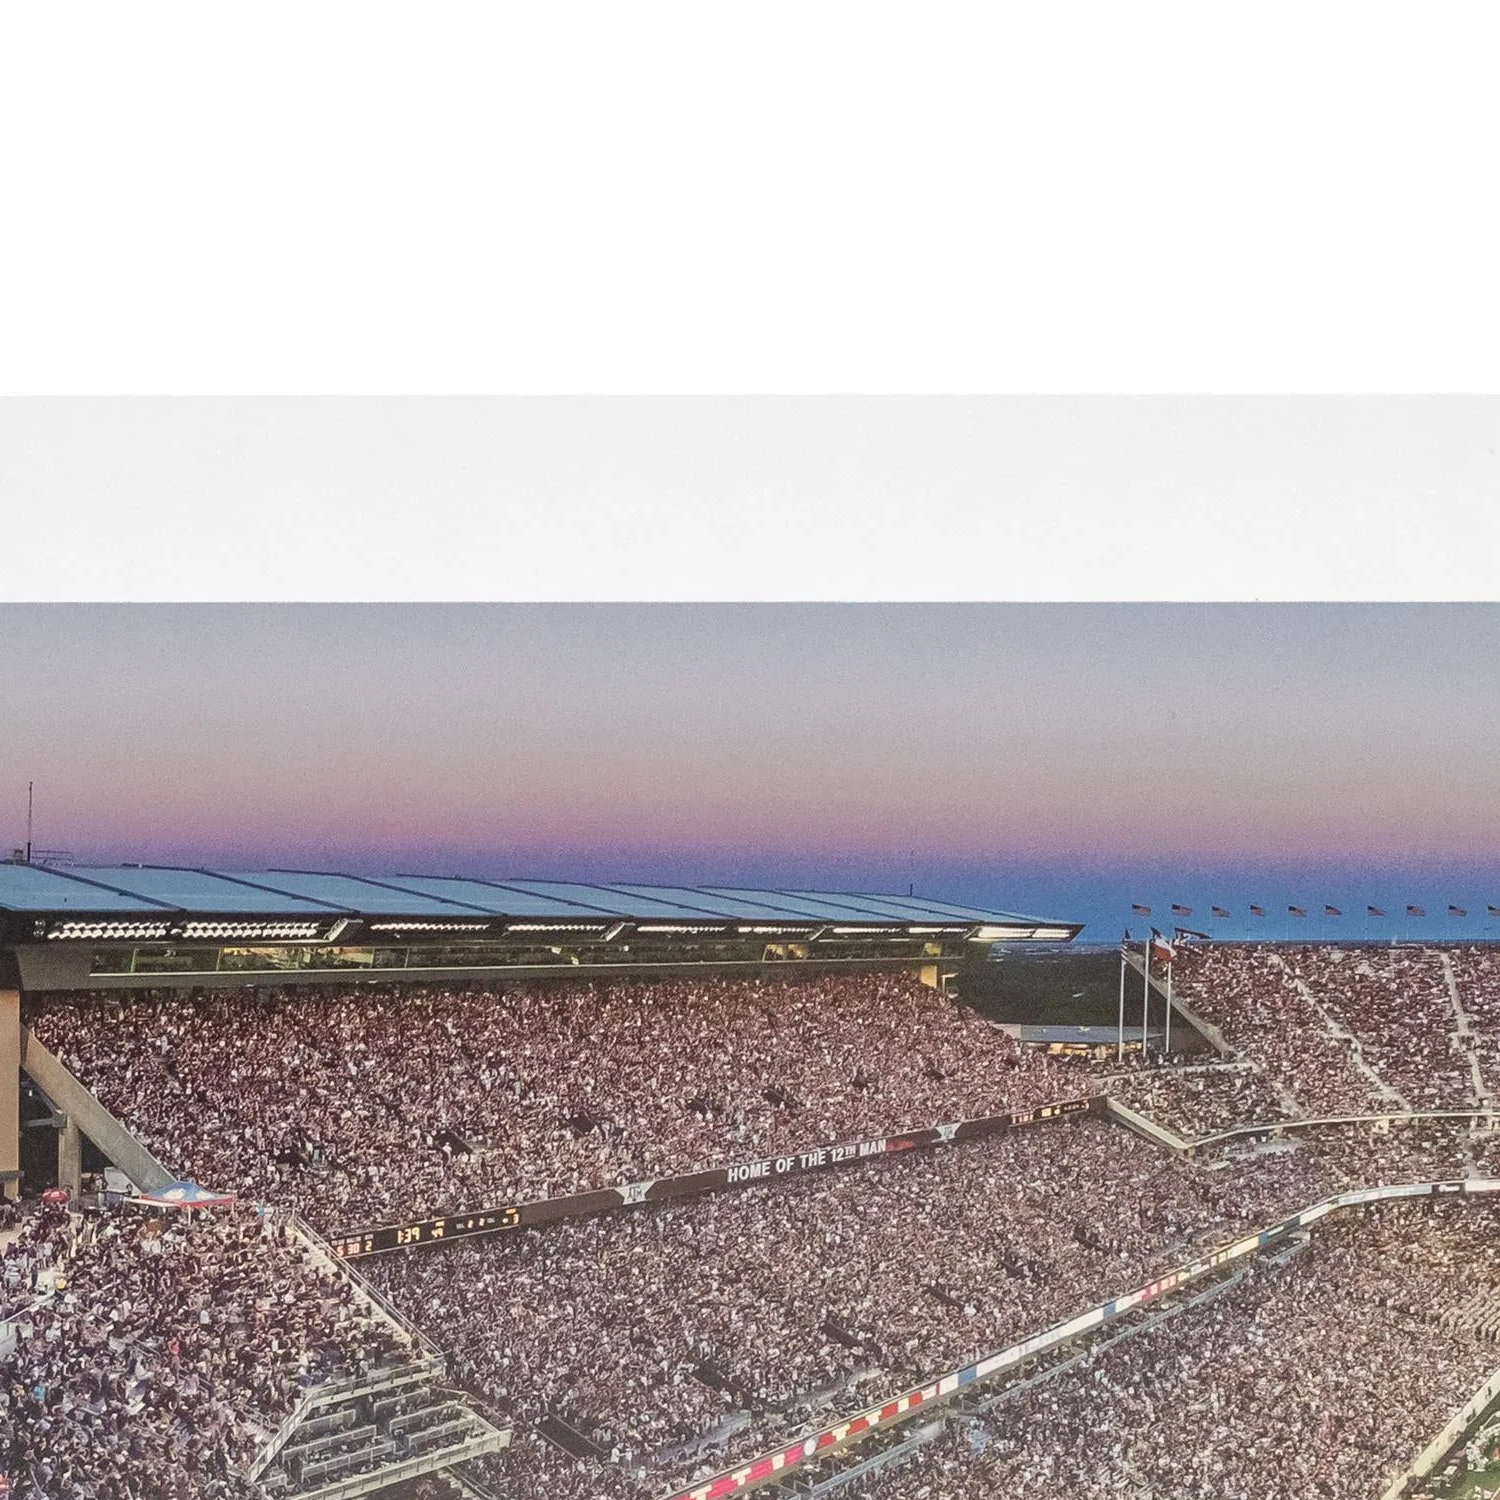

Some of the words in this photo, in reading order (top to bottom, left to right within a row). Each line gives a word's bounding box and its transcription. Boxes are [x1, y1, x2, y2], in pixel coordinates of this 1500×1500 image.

[727, 1162, 771, 1183] HOME
[775, 1158, 796, 1173] OF
[800, 1150, 827, 1169] THE
[860, 1139, 887, 1157] MAN
[397, 1227, 421, 1244] 1:39
